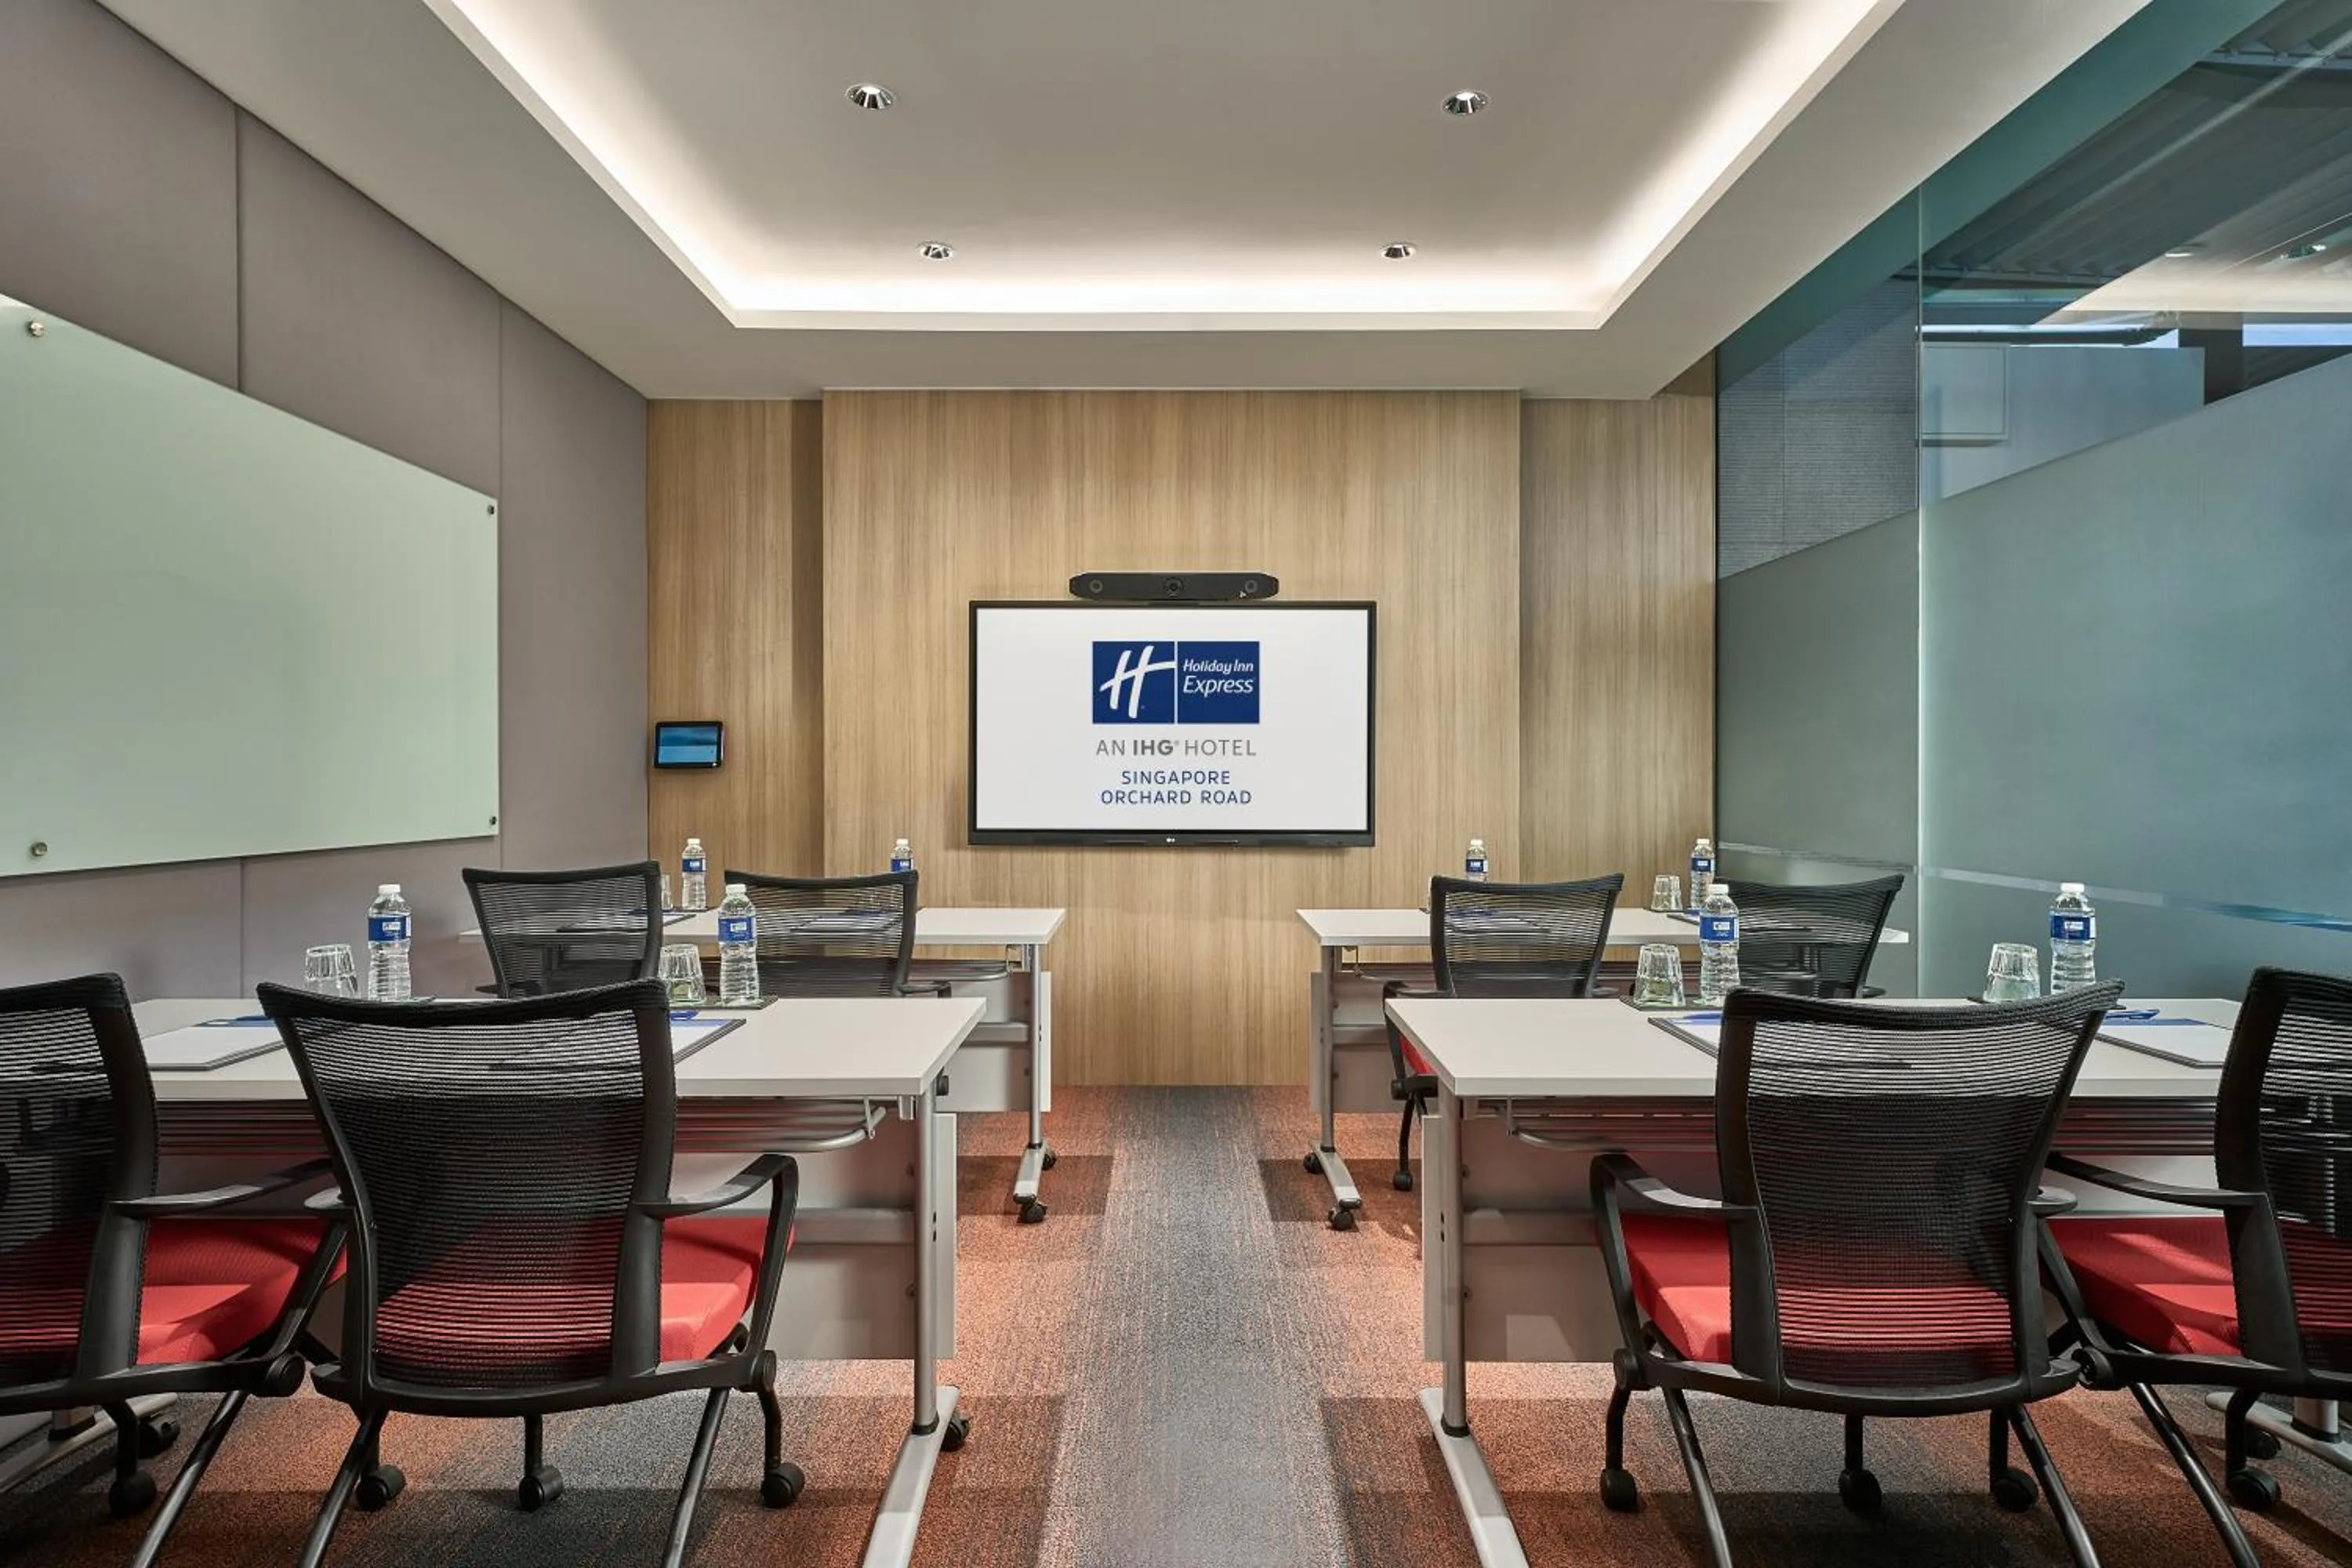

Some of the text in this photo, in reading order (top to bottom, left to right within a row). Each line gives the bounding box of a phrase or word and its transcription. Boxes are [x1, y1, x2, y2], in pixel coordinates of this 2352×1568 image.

[1183, 659, 1254, 675] Holiday Inn
[1183, 676, 1254, 698] Express
[1096, 739, 1125, 756] AN
[1185, 739, 1257, 756] HOTEL
[1122, 771, 1230, 785] SINGAPORE
[1101, 789, 1253, 804] ORCHARD ROAD
